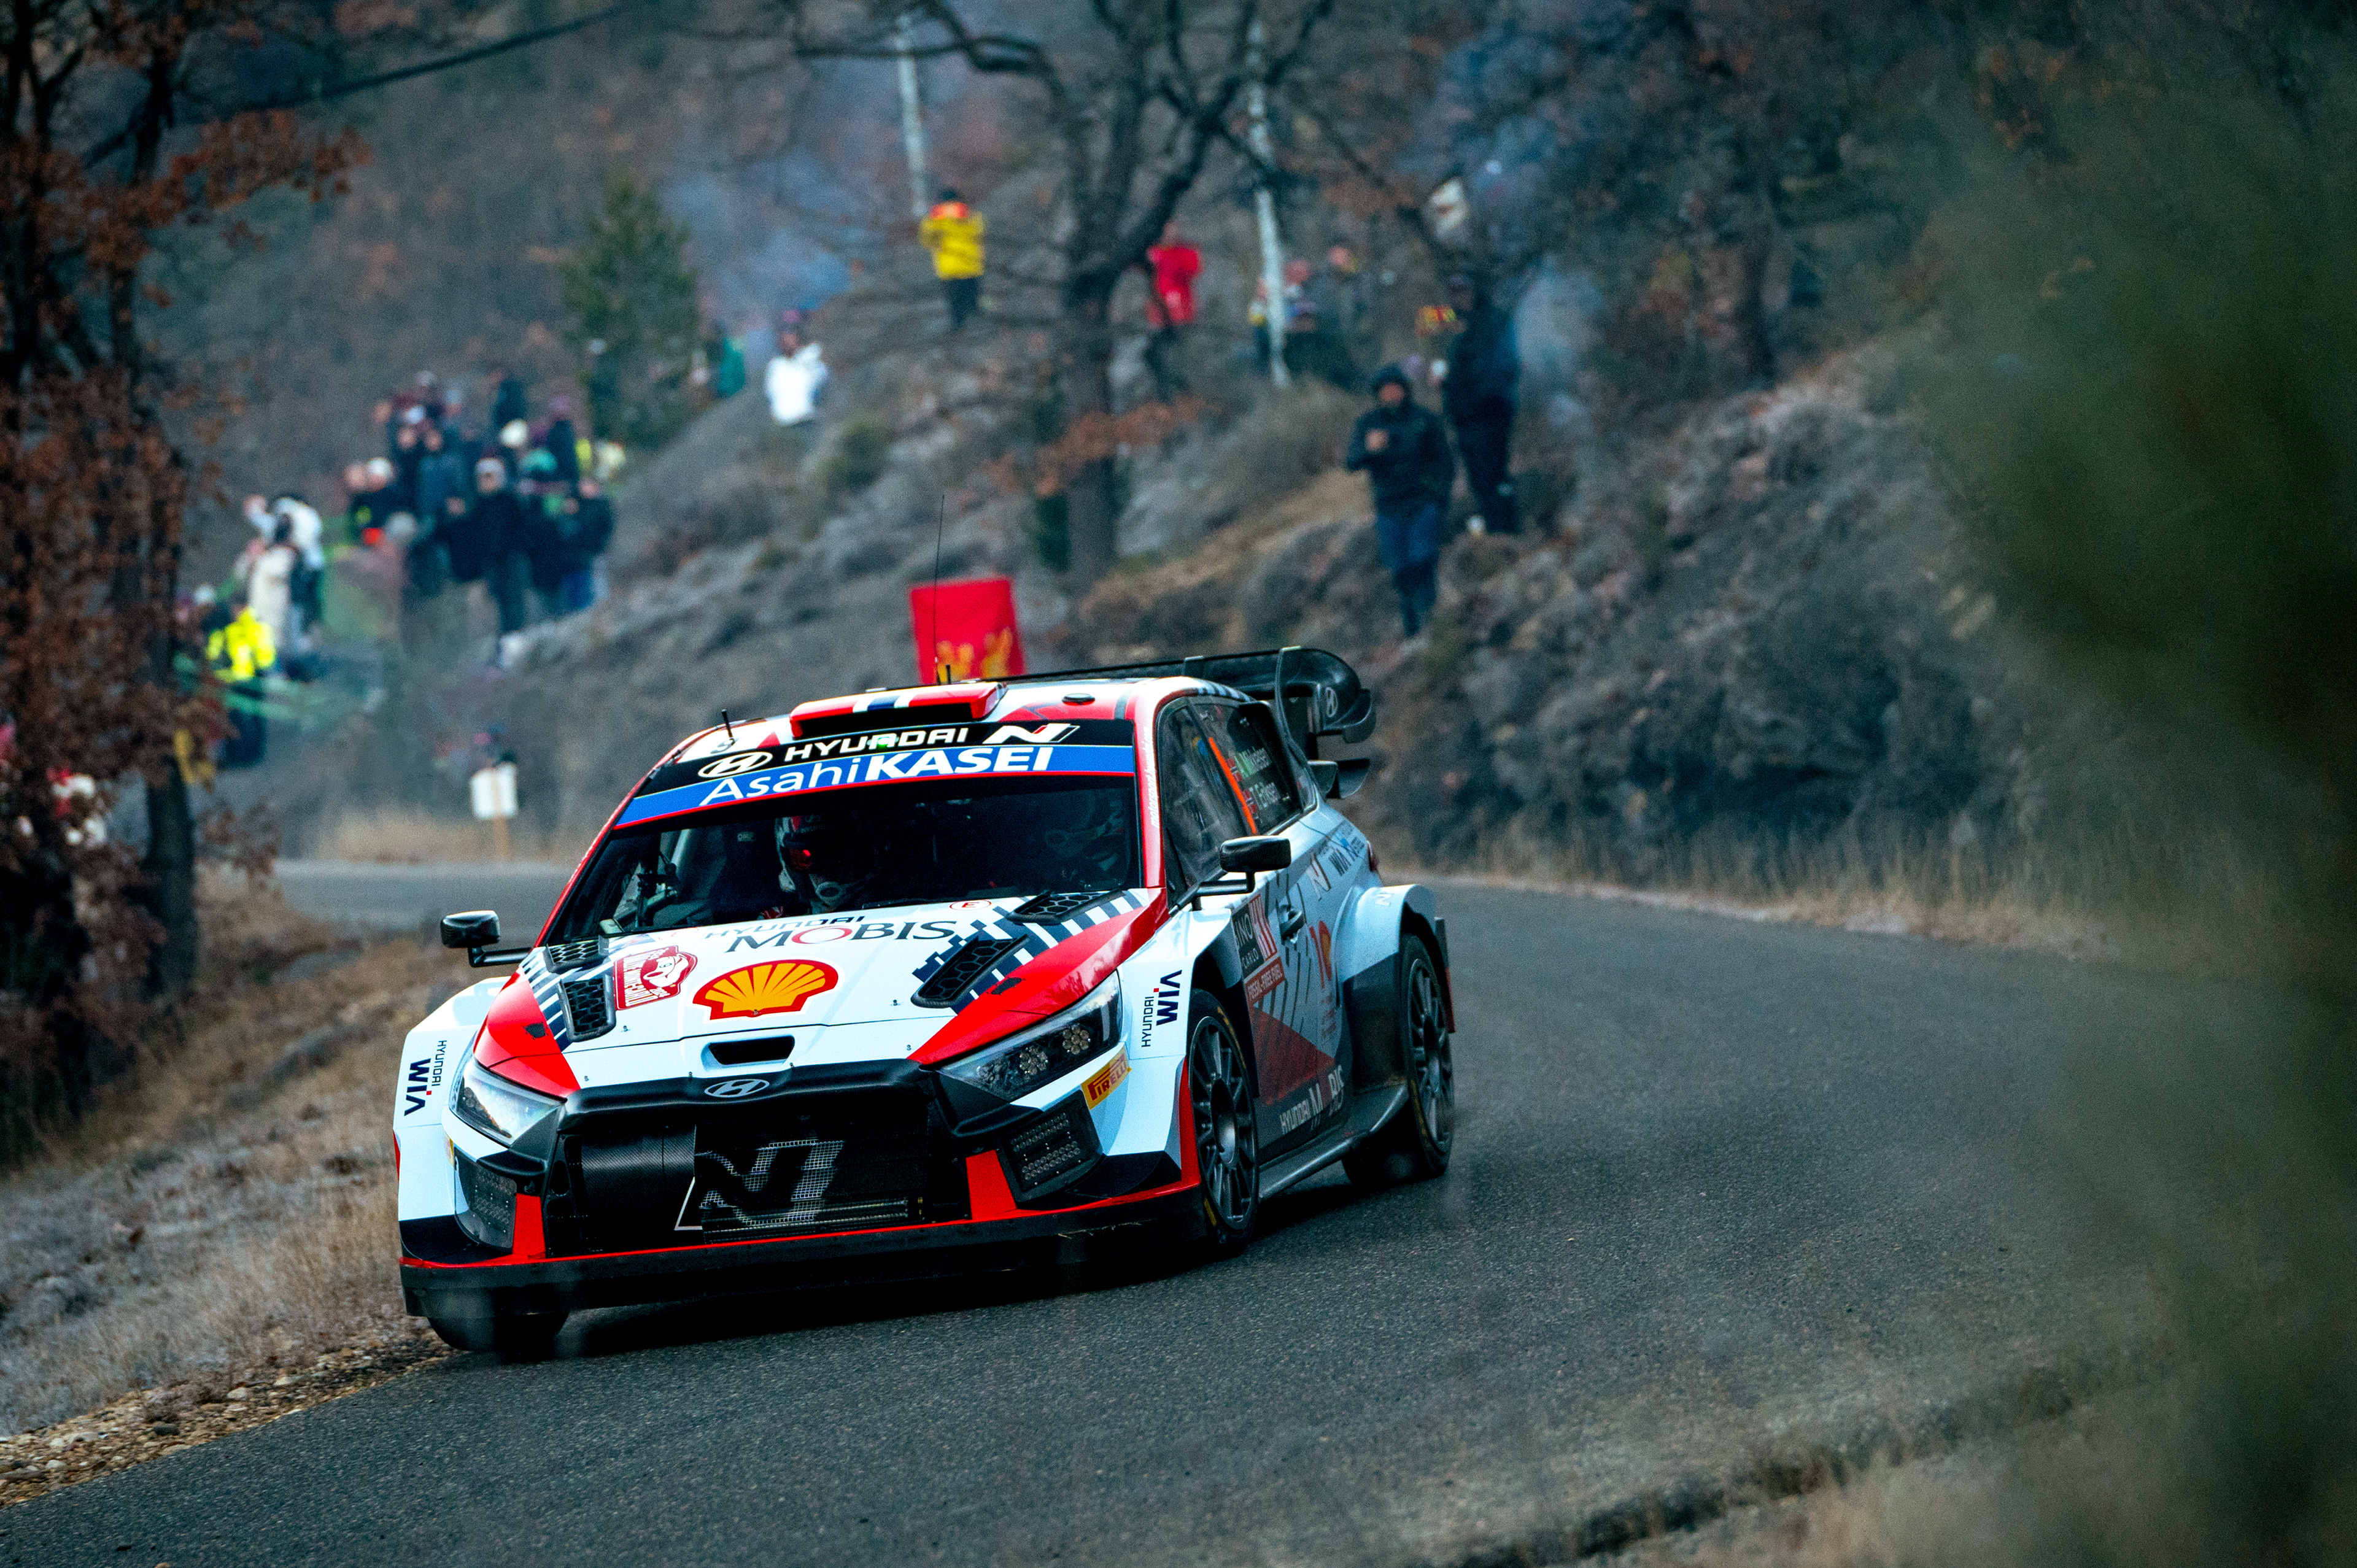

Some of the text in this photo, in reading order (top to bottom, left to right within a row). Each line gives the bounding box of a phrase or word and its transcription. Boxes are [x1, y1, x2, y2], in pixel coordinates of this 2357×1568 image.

[784, 727, 969, 762] HYUNDAI
[705, 916, 865, 939] HYUNDAI
[724, 921, 958, 953] MOBIS
[1155, 970, 1182, 1026] WIA
[1141, 996, 1155, 1047] HYUNDAI
[432, 1040, 447, 1086] HYUNDAI
[1088, 1054, 1127, 1101] PIRELLI
[404, 1058, 432, 1116] WIA
